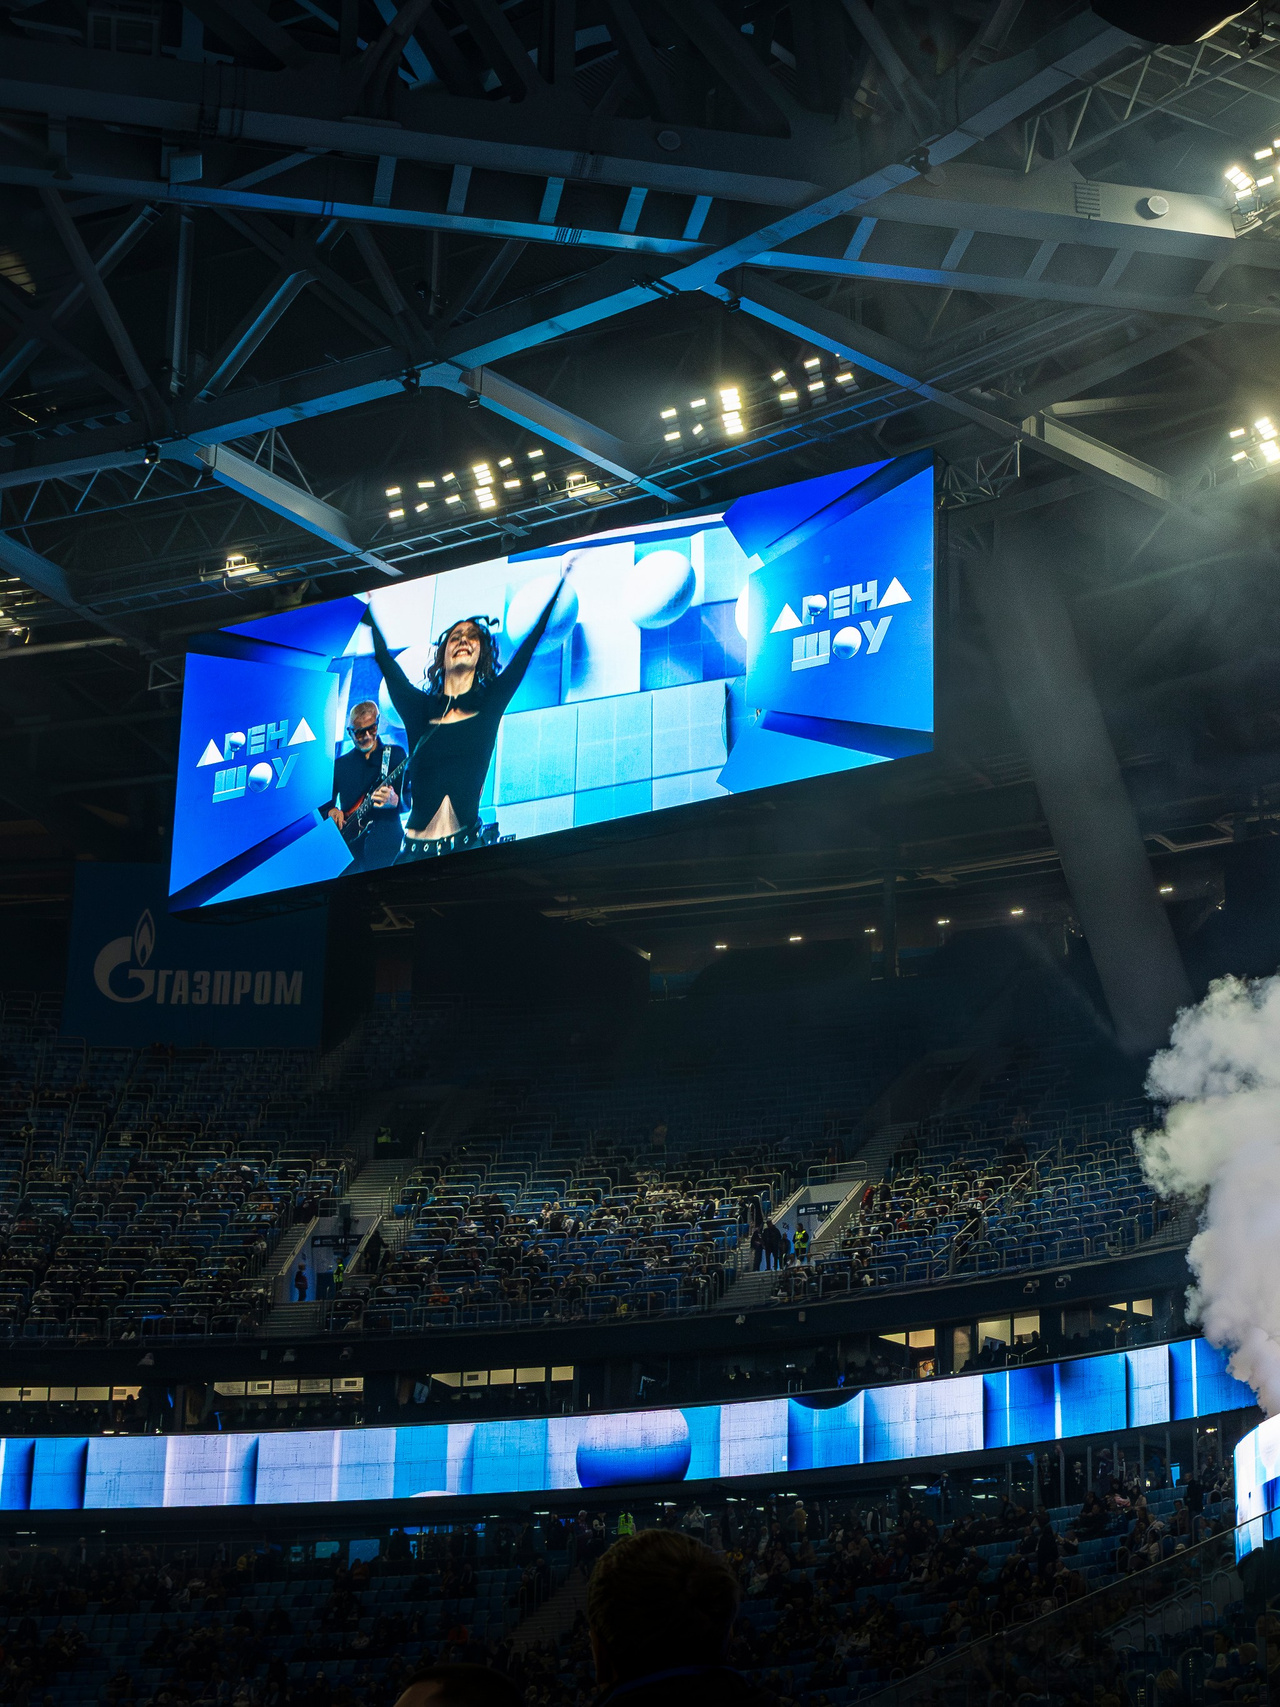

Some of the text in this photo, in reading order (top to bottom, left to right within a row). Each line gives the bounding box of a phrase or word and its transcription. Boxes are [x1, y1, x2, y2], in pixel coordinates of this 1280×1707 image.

[770, 576, 912, 634] АРЕНА
[791, 615, 893, 672] ШОУ
[196, 716, 317, 768] АРЕНА
[212, 752, 300, 803] ШОУ
[156, 969, 304, 1005] ГАЗПРОМ
